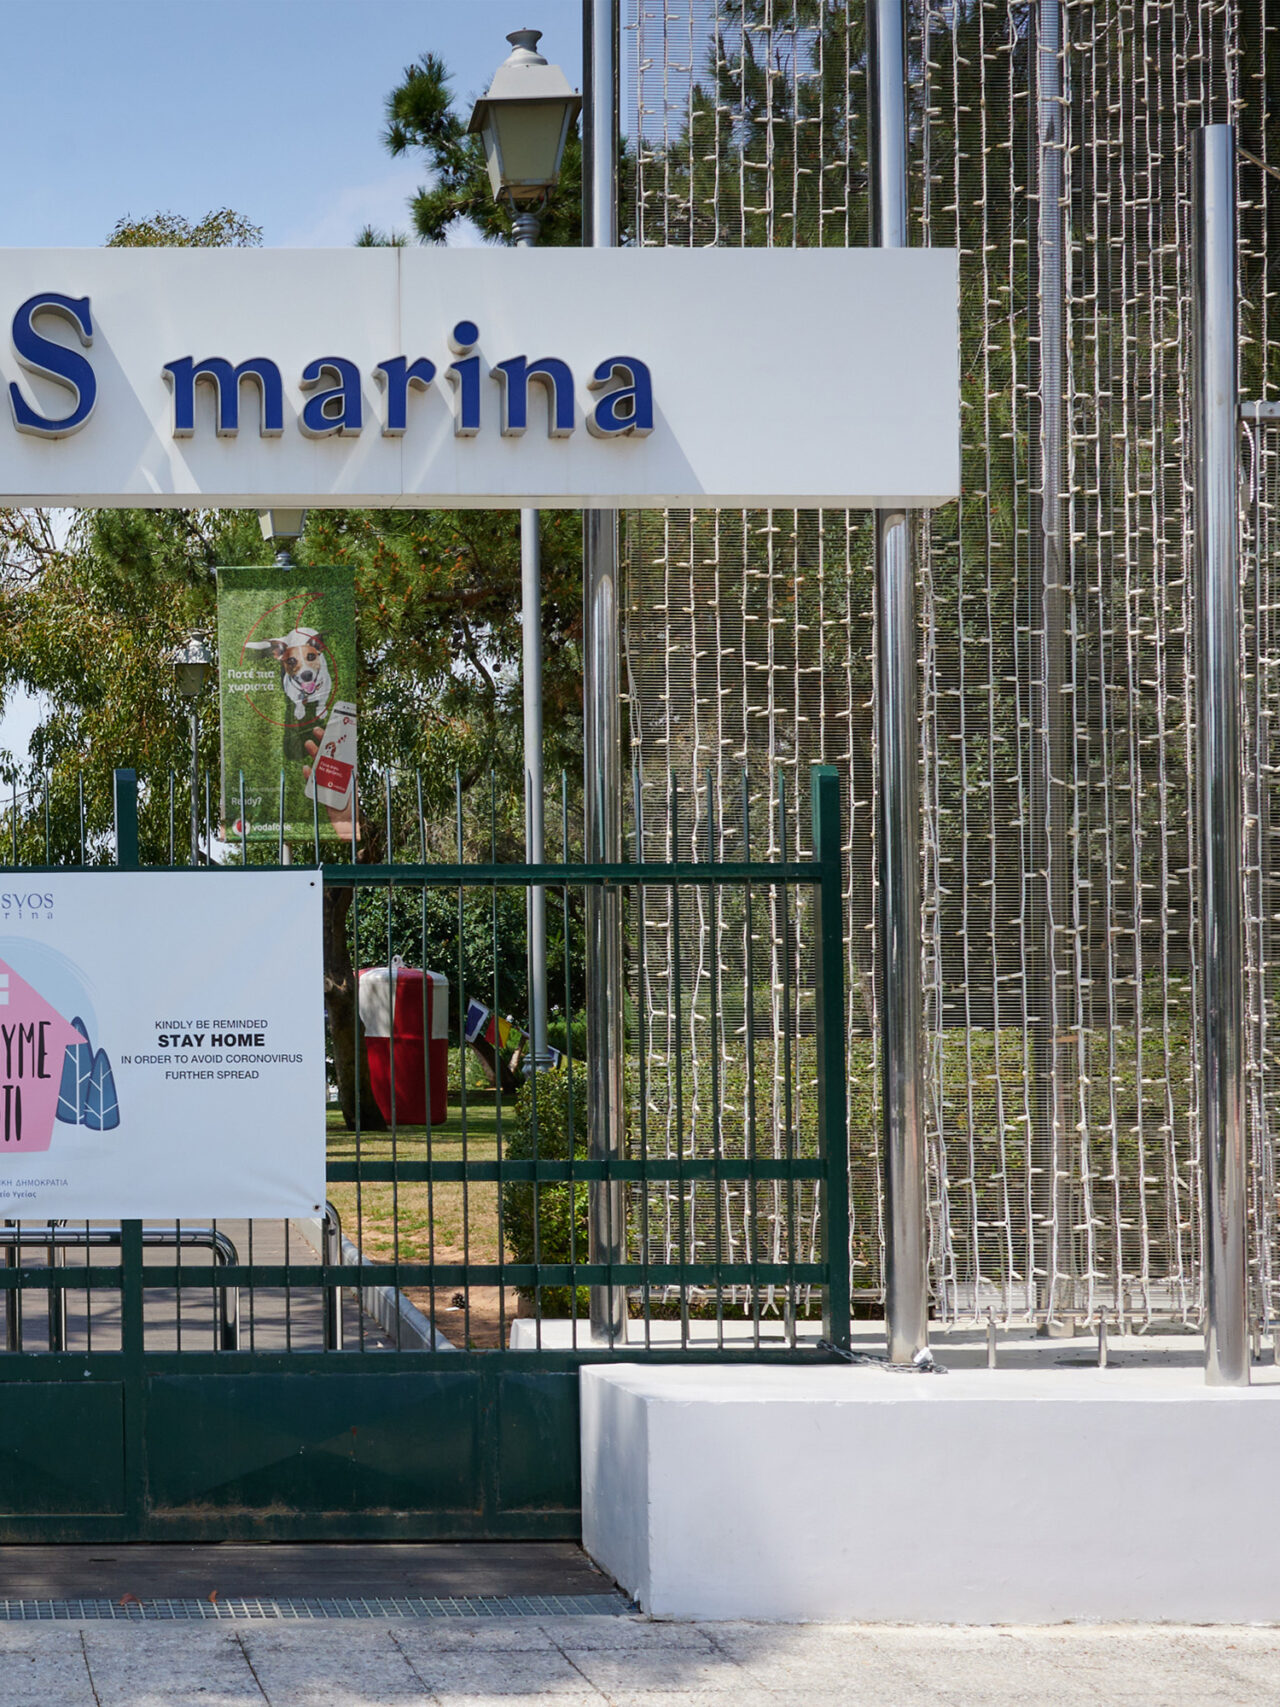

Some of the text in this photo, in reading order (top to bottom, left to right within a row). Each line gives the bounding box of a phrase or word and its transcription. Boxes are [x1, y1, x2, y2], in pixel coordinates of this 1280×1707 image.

[163, 321, 654, 439] marina
[227, 668, 275, 679] Ποτέ πια
[227, 681, 275, 694] χωριστά
[231, 796, 263, 808] Redy?
[252, 823, 292, 832] vodafoe
[154, 1019, 269, 1030] KINDLY BE REMINDED
[157, 1033, 266, 1048] STAY HOME
[121, 1053, 303, 1065] IN ORDER TO AVOID CORONOVIRUS
[165, 1070, 260, 1080] FURTHER SPREAD
[15, 1178, 69, 1187] ΔΗΜΟΚΡΑΤΙΑ
[12, 1190, 38, 1199] Υγείας
